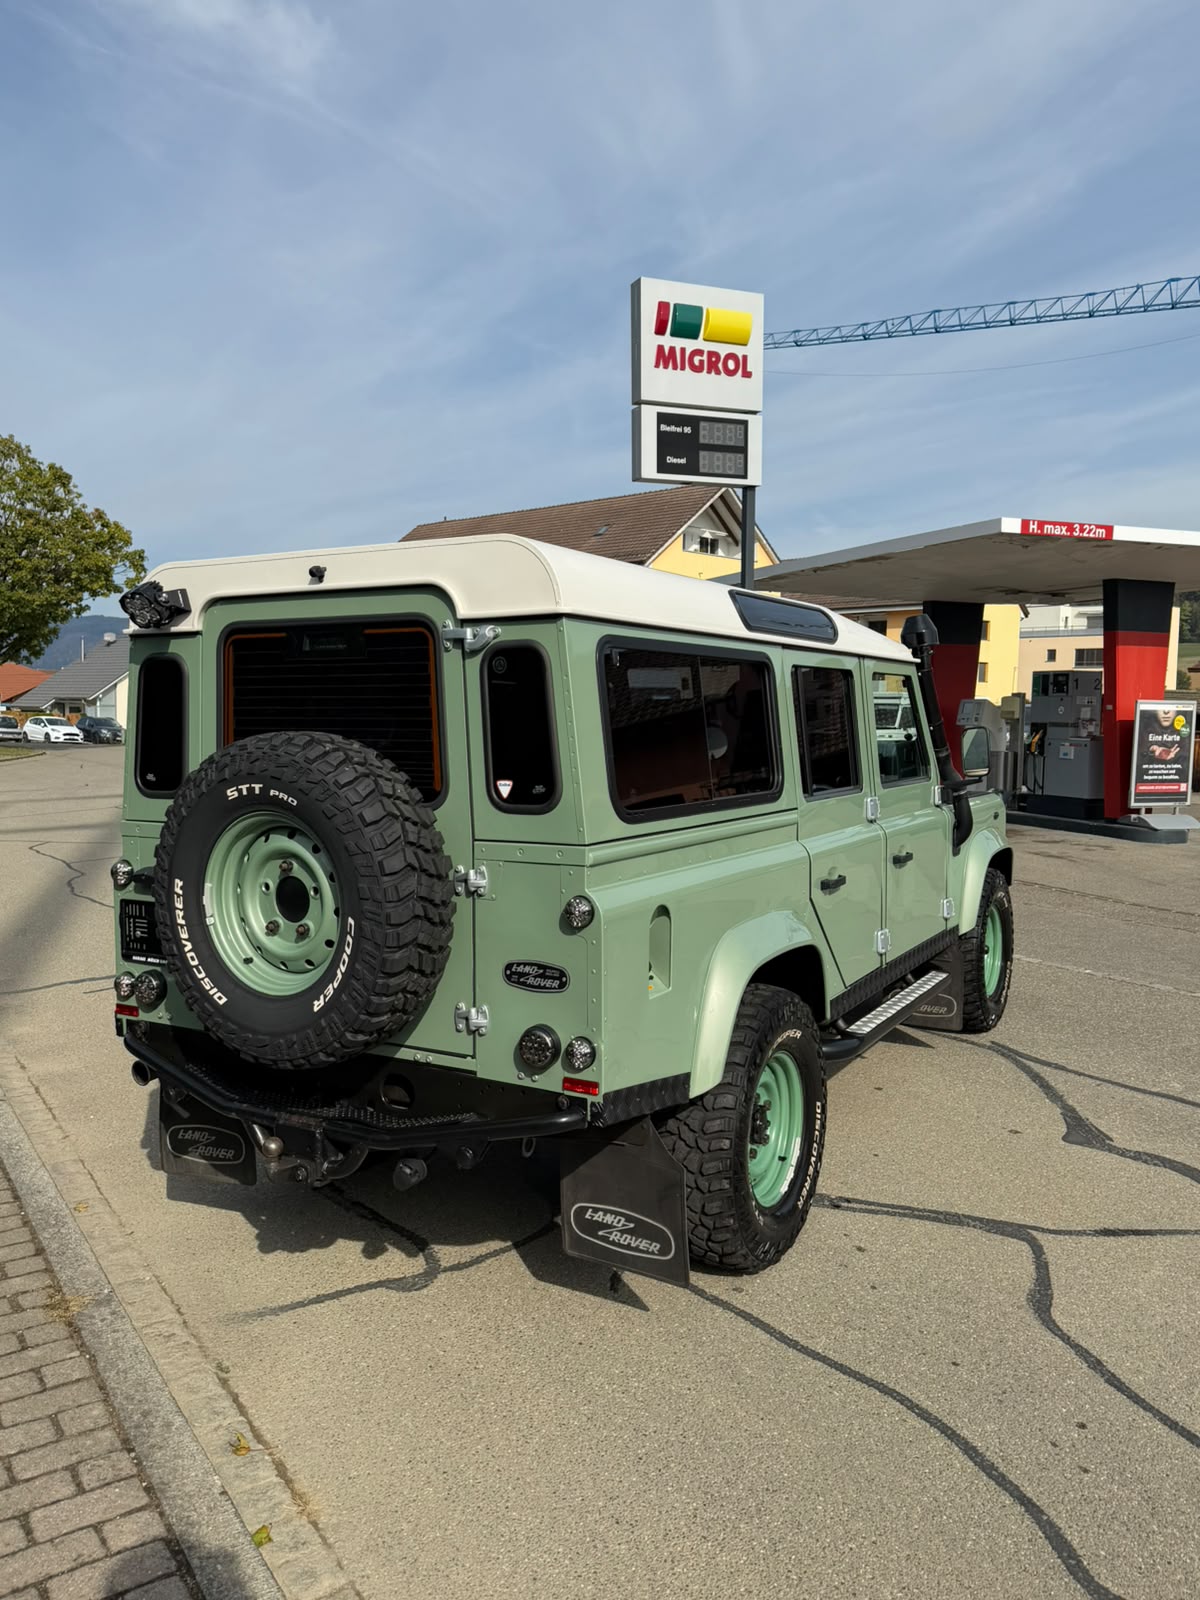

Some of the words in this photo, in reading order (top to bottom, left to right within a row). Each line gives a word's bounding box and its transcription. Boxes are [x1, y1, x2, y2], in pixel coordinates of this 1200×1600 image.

[654, 344, 753, 379] MIGROL
[660, 424, 683, 433] Bleifrei
[683, 426, 692, 434] 95
[666, 456, 687, 464] Diesel
[1029, 520, 1042, 533] H.
[1043, 524, 1071, 536] max.
[1073, 524, 1106, 538] 3.22m
[1073, 678, 1079, 690] 1
[1094, 678, 1101, 690] 2
[1149, 733, 1162, 741] Eine
[226, 783, 263, 800] STT
[269, 789, 298, 807] PRO
[174, 878, 228, 1005] DISCOVERER
[312, 917, 355, 1013] COOPER
[511, 963, 538, 974] LAND
[526, 977, 560, 988] ROVER
[178, 1128, 208, 1141] LAND
[196, 1146, 235, 1159] ROVER
[798, 1101, 822, 1208] DISCOVERER
[585, 1208, 626, 1227] LAND
[608, 1231, 660, 1254] ROVER
